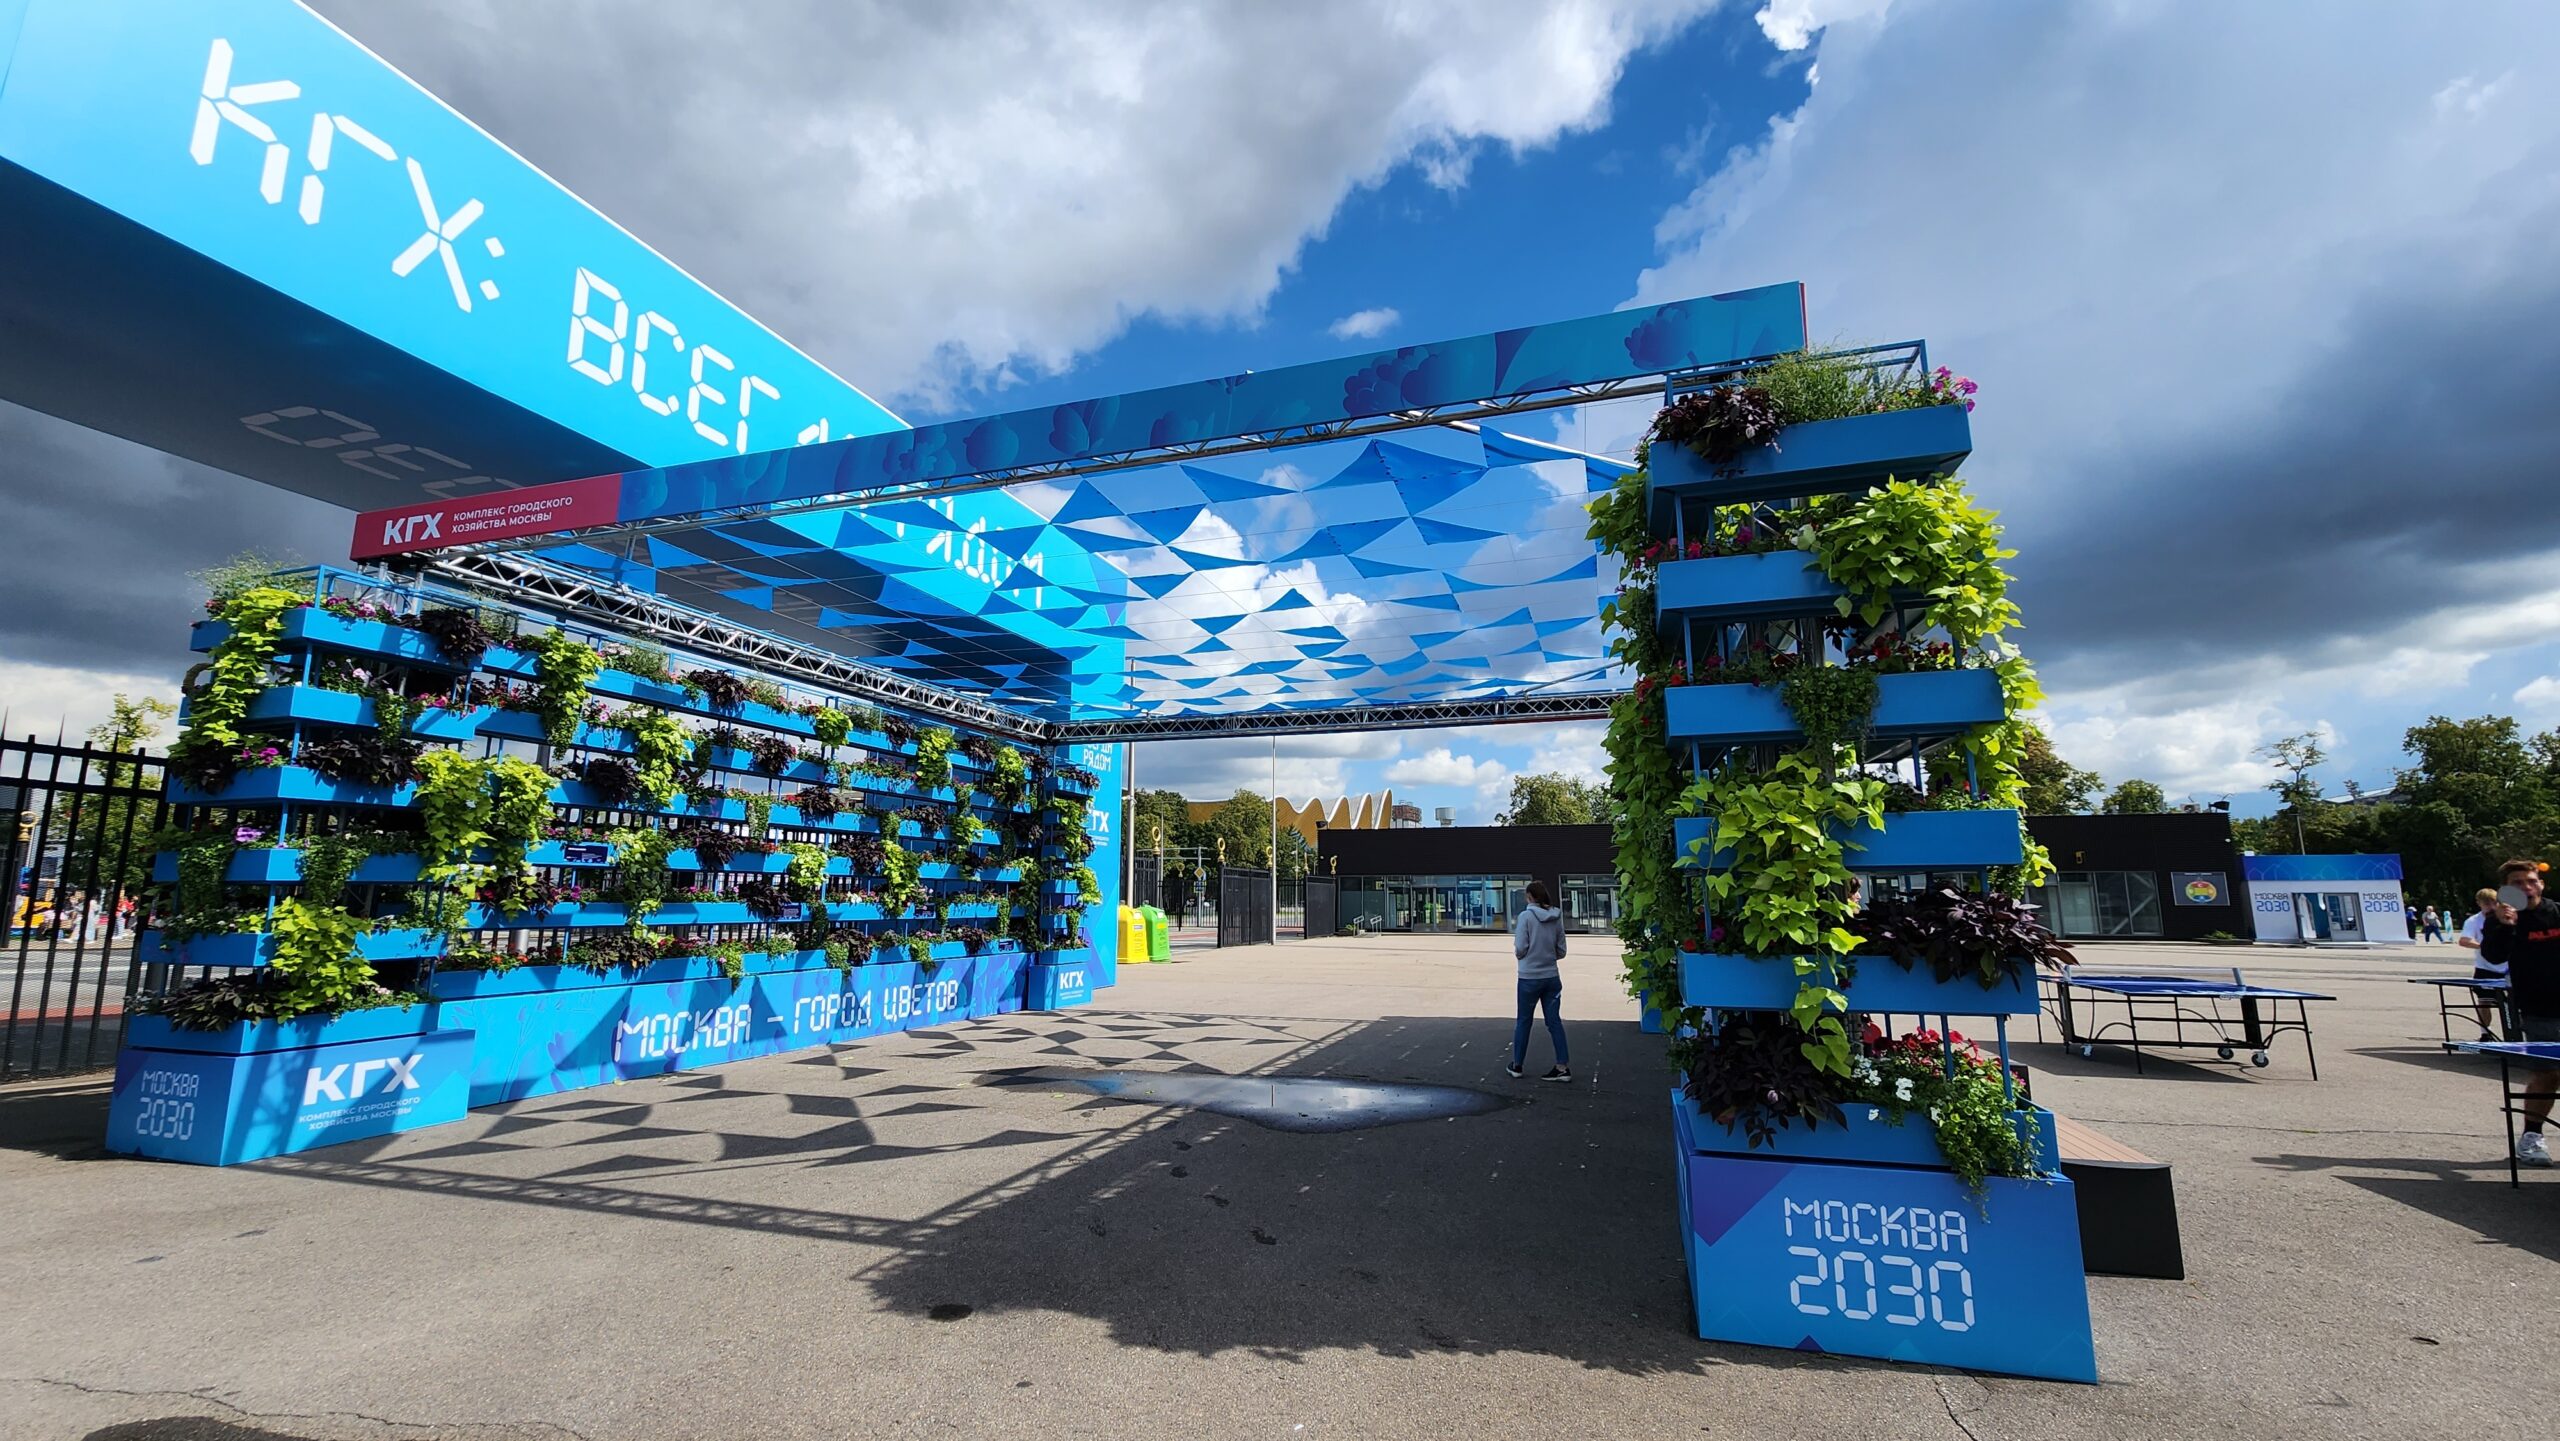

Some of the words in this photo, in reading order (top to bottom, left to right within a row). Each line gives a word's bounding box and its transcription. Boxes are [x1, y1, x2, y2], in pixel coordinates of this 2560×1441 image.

[190, 38, 505, 313] КГХ:
[567, 266, 857, 456] ВСЕГ
[453, 506, 506, 521] КОМПЛЕКС
[507, 496, 573, 515] ГОРОДСКОГО
[383, 512, 443, 545] КГХ
[451, 518, 507, 534] ХОЗЯЙСТВА
[508, 512, 552, 527] МОСКВЫ
[2254, 893, 2289, 901] МОСКВА
[2256, 901, 2290, 912] 2030
[2363, 893, 2398, 901] МОСКВА
[2365, 901, 2400, 913] 2030
[1060, 970, 1084, 989] КГХ
[614, 1003, 752, 1062] МОСКВА
[794, 990, 872, 1035] ГОРОД
[883, 979, 958, 1022] ЦВЕТОВ
[141, 1070, 200, 1098] МОСКВА
[303, 1053, 424, 1107] КГХ
[136, 1097, 195, 1141] 2030
[299, 1107, 357, 1124] КОМПЛЕКС
[358, 1096, 421, 1112] ГОРОДСКОГО
[308, 1113, 368, 1131] ХОЗЯЙСТВА
[370, 1106, 412, 1121] МОСКВЫ
[1784, 1196, 1968, 1255] МОСКВА
[1787, 1245, 1975, 1332] 2030
